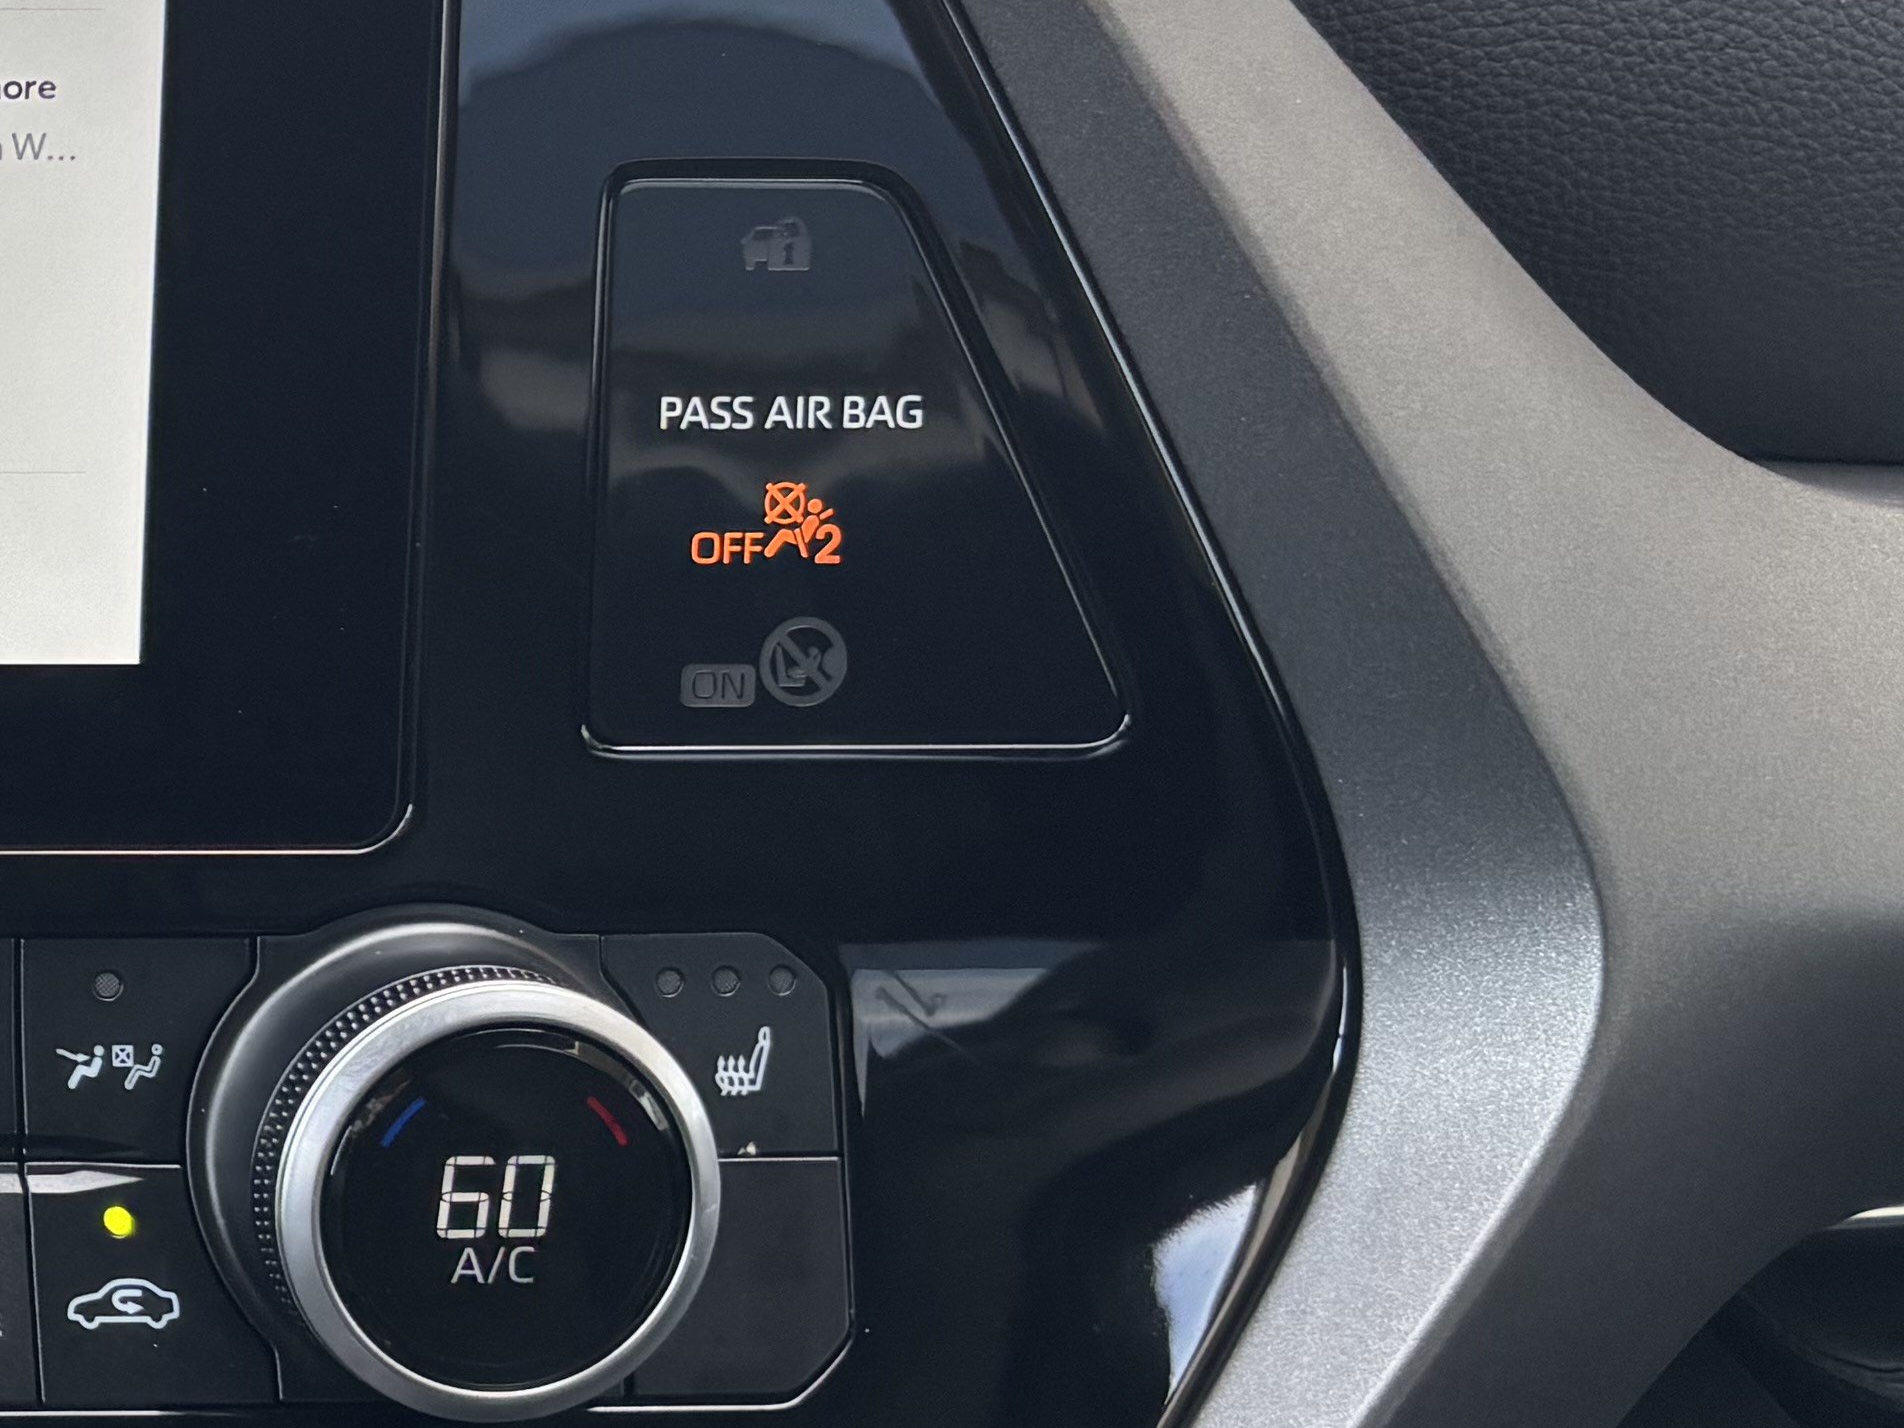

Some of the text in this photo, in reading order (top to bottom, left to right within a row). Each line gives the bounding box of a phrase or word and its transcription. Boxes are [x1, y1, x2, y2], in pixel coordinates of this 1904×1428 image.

[659, 395, 924, 430] PASS AIR BAG
[691, 531, 764, 565] OFF
[692, 670, 746, 700] ON
[436, 1155, 556, 1240] 60
[451, 1246, 536, 1285] A/C
